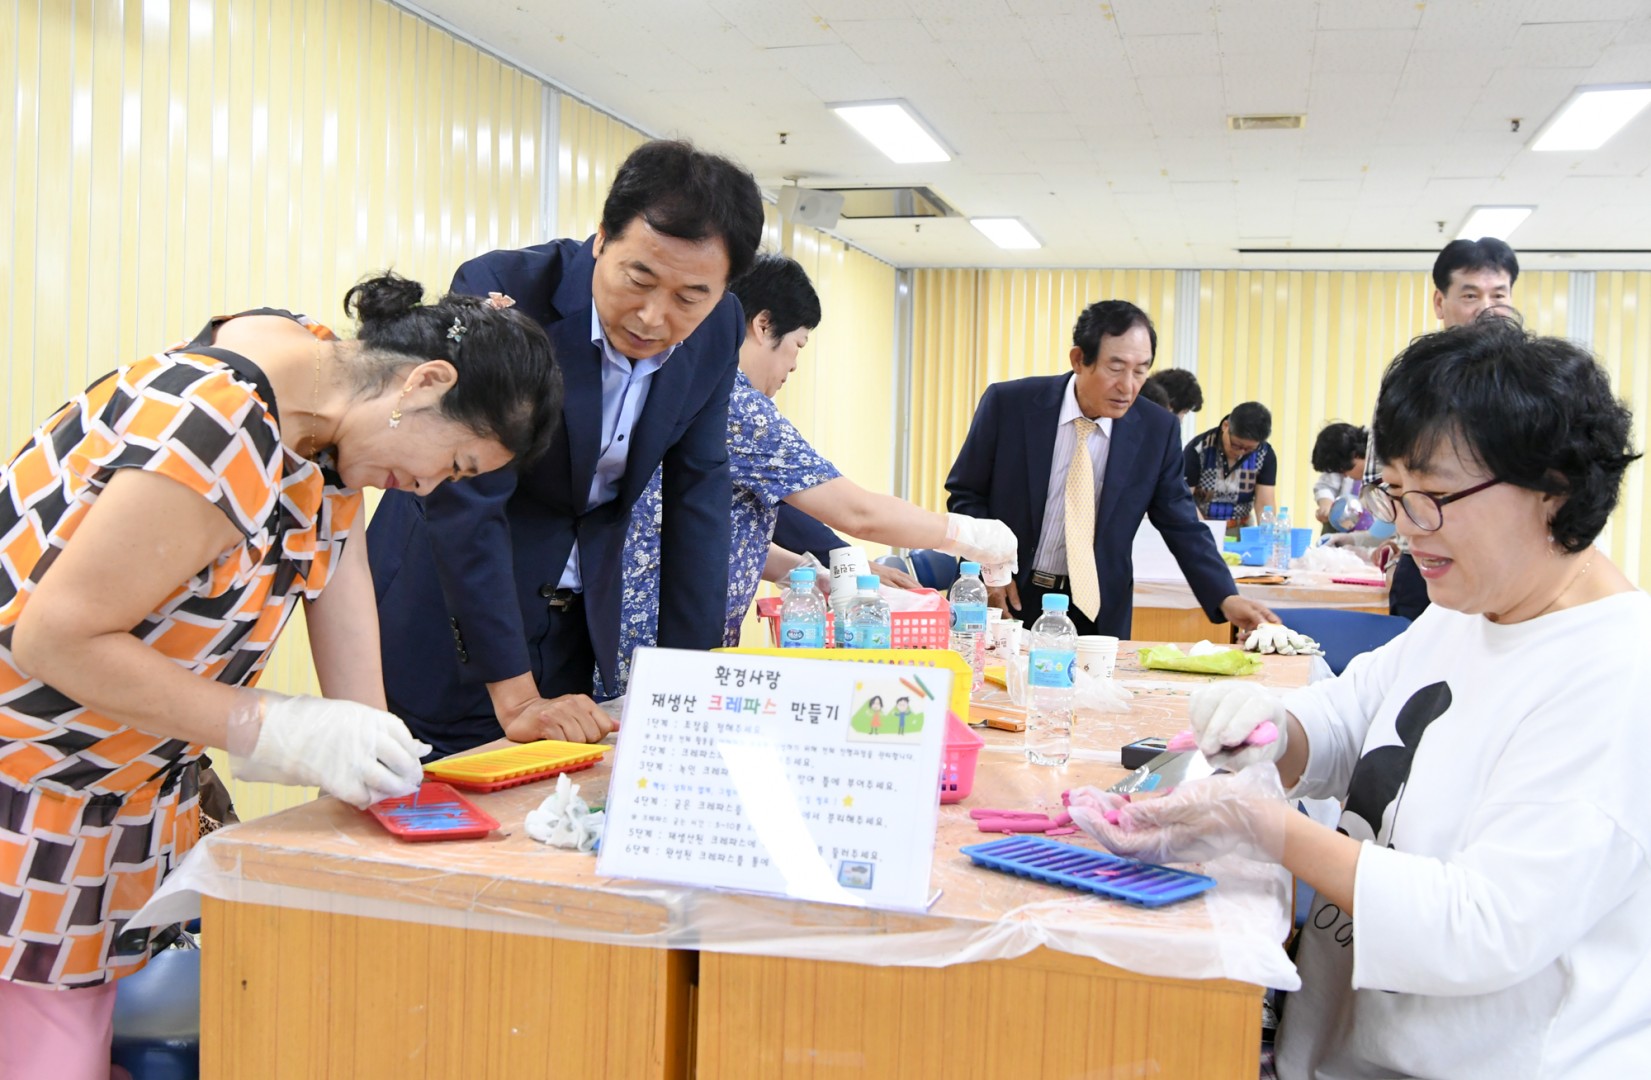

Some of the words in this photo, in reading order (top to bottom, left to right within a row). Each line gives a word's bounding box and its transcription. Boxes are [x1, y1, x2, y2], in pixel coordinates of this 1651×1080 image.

[715, 666, 781, 690] 환경사랑
[652, 693, 697, 713] 재생산
[708, 695, 777, 715] 크레파스
[791, 702, 839, 724] 만들기
[646, 718, 668, 729] 1단계
[642, 744, 666, 757] 2단계
[639, 761, 663, 772] 3단계
[702, 766, 729, 777] 크레파
[848, 778, 898, 792] 부어주세요.
[634, 796, 658, 807] 4단계
[828, 813, 887, 828] 분리해주세요.
[628, 828, 652, 839] 5단계
[625, 844, 650, 855] 6단계
[698, 851, 743, 867] 크레파스를
